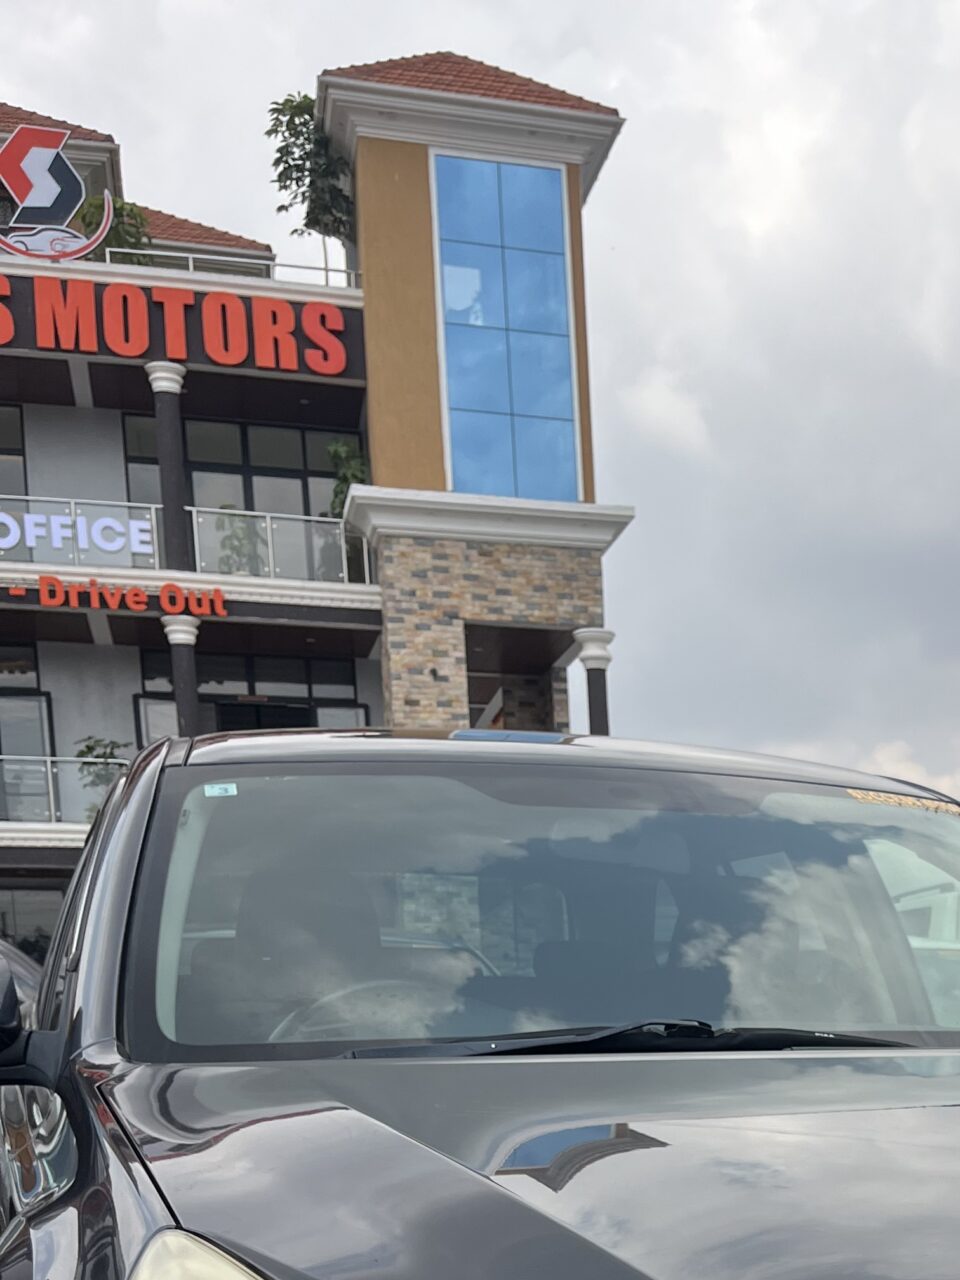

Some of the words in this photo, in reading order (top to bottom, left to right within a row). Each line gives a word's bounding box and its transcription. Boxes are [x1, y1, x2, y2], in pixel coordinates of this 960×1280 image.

[33, 275, 347, 376] MOTORS
[38, 575, 148, 612] Drive
[159, 582, 227, 617] Out
